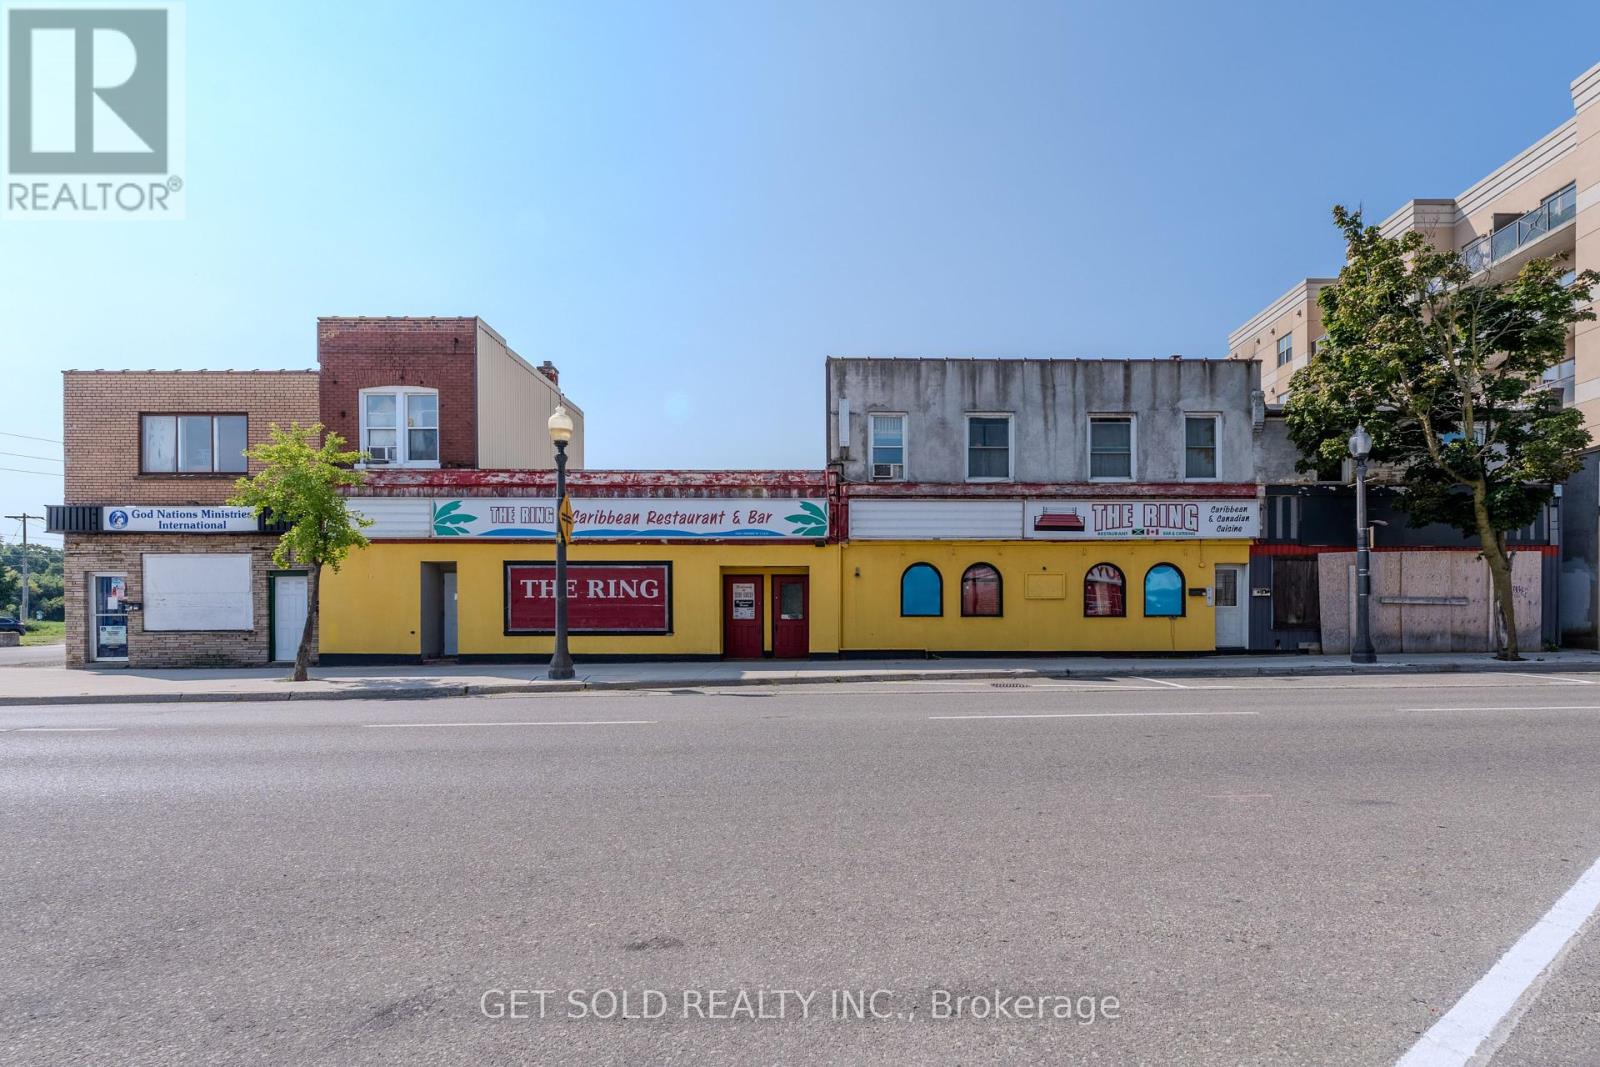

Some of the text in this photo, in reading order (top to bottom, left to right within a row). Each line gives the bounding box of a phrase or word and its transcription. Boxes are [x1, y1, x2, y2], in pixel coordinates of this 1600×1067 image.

[131, 509, 154, 519] God
[156, 509, 198, 519] Nations
[1210, 505, 1248, 513] Caribbean
[490, 506, 554, 524] THE RING
[572, 509, 773, 525] Caribbean Restaurant & Bar
[1092, 503, 1199, 532] THE RING
[1208, 514, 1250, 523] & Canadian
[158, 520, 227, 530] International
[1216, 525, 1243, 533] Cuisine
[520, 579, 659, 599] THE RING
